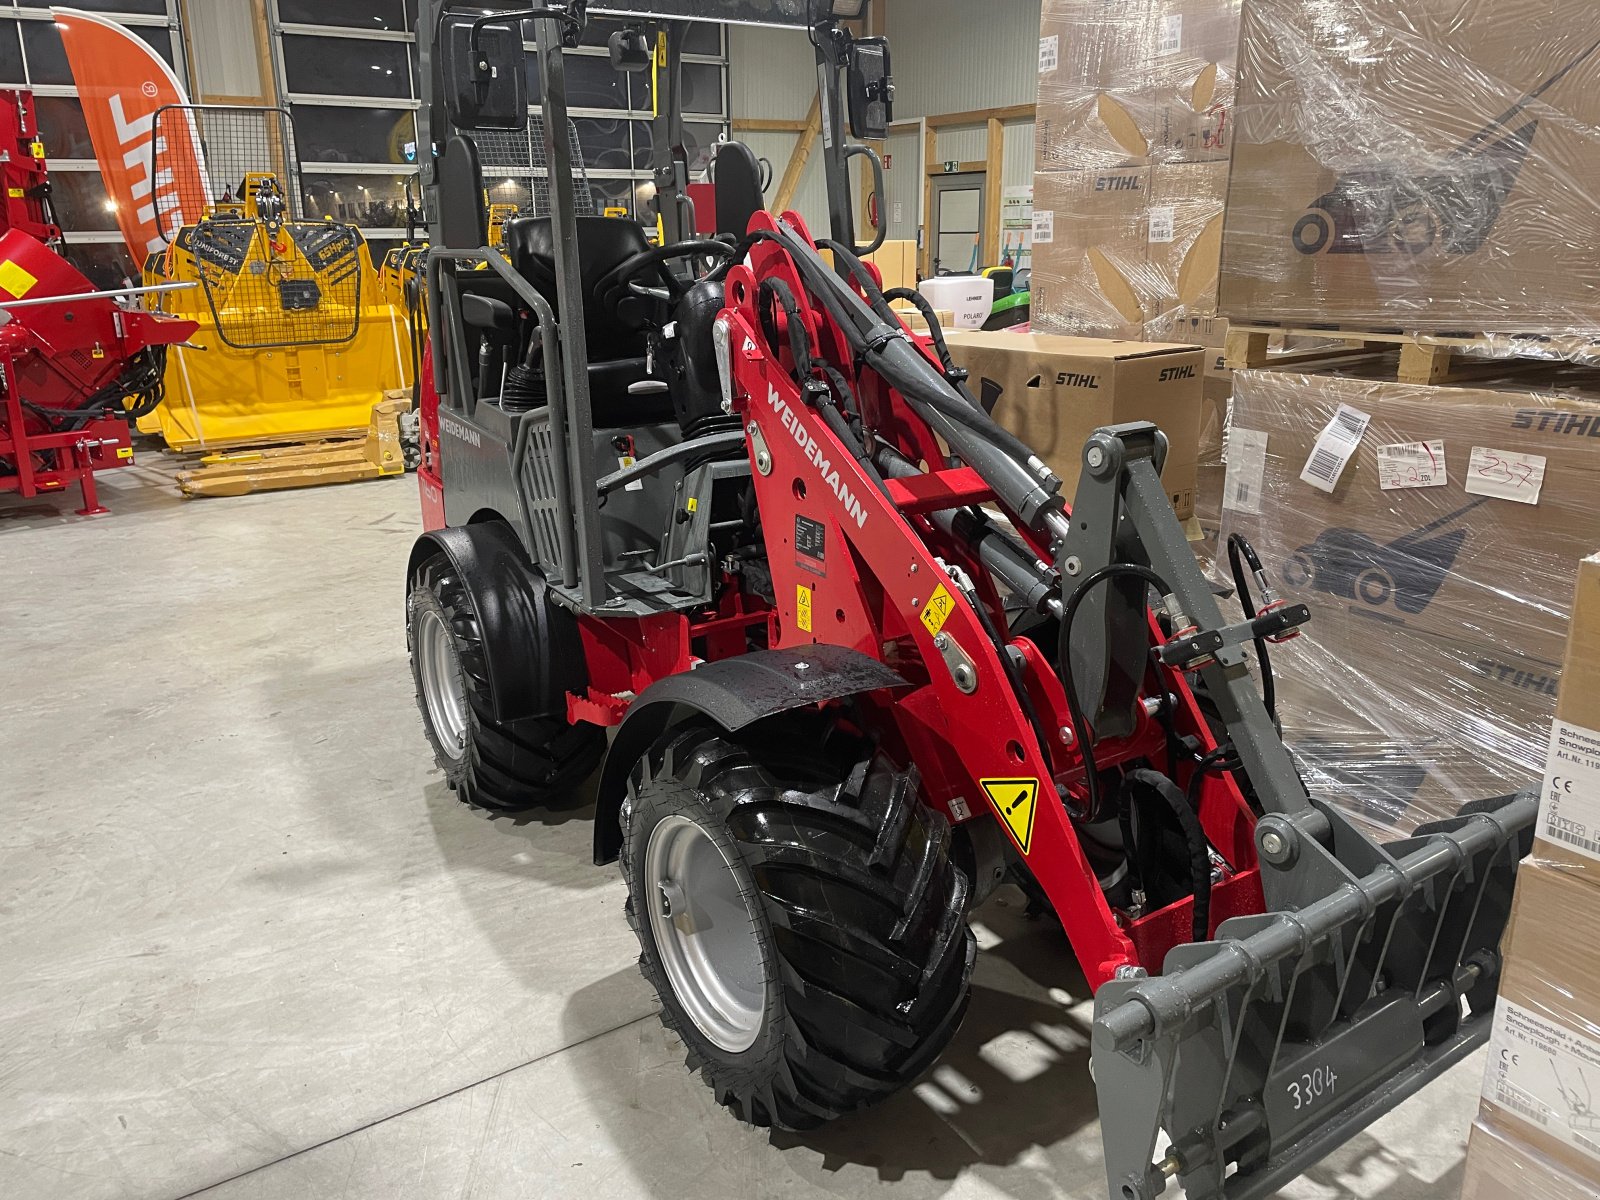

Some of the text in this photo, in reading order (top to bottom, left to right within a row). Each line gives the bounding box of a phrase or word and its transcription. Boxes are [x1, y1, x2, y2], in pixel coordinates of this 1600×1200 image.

[1095, 176, 1140, 191] STIHL
[1056, 372, 1098, 388] STIHL
[1158, 365, 1195, 382] STIHL
[439, 416, 481, 448] WEIDEMANN
[767, 381, 868, 529] WEIDEMANN
[1478, 455, 1534, 488] 237
[1506, 1014, 1561, 1047] Snowplough
[1507, 1006, 1566, 1040] Schneeschild
[1286, 1065, 1337, 1110] 3304
